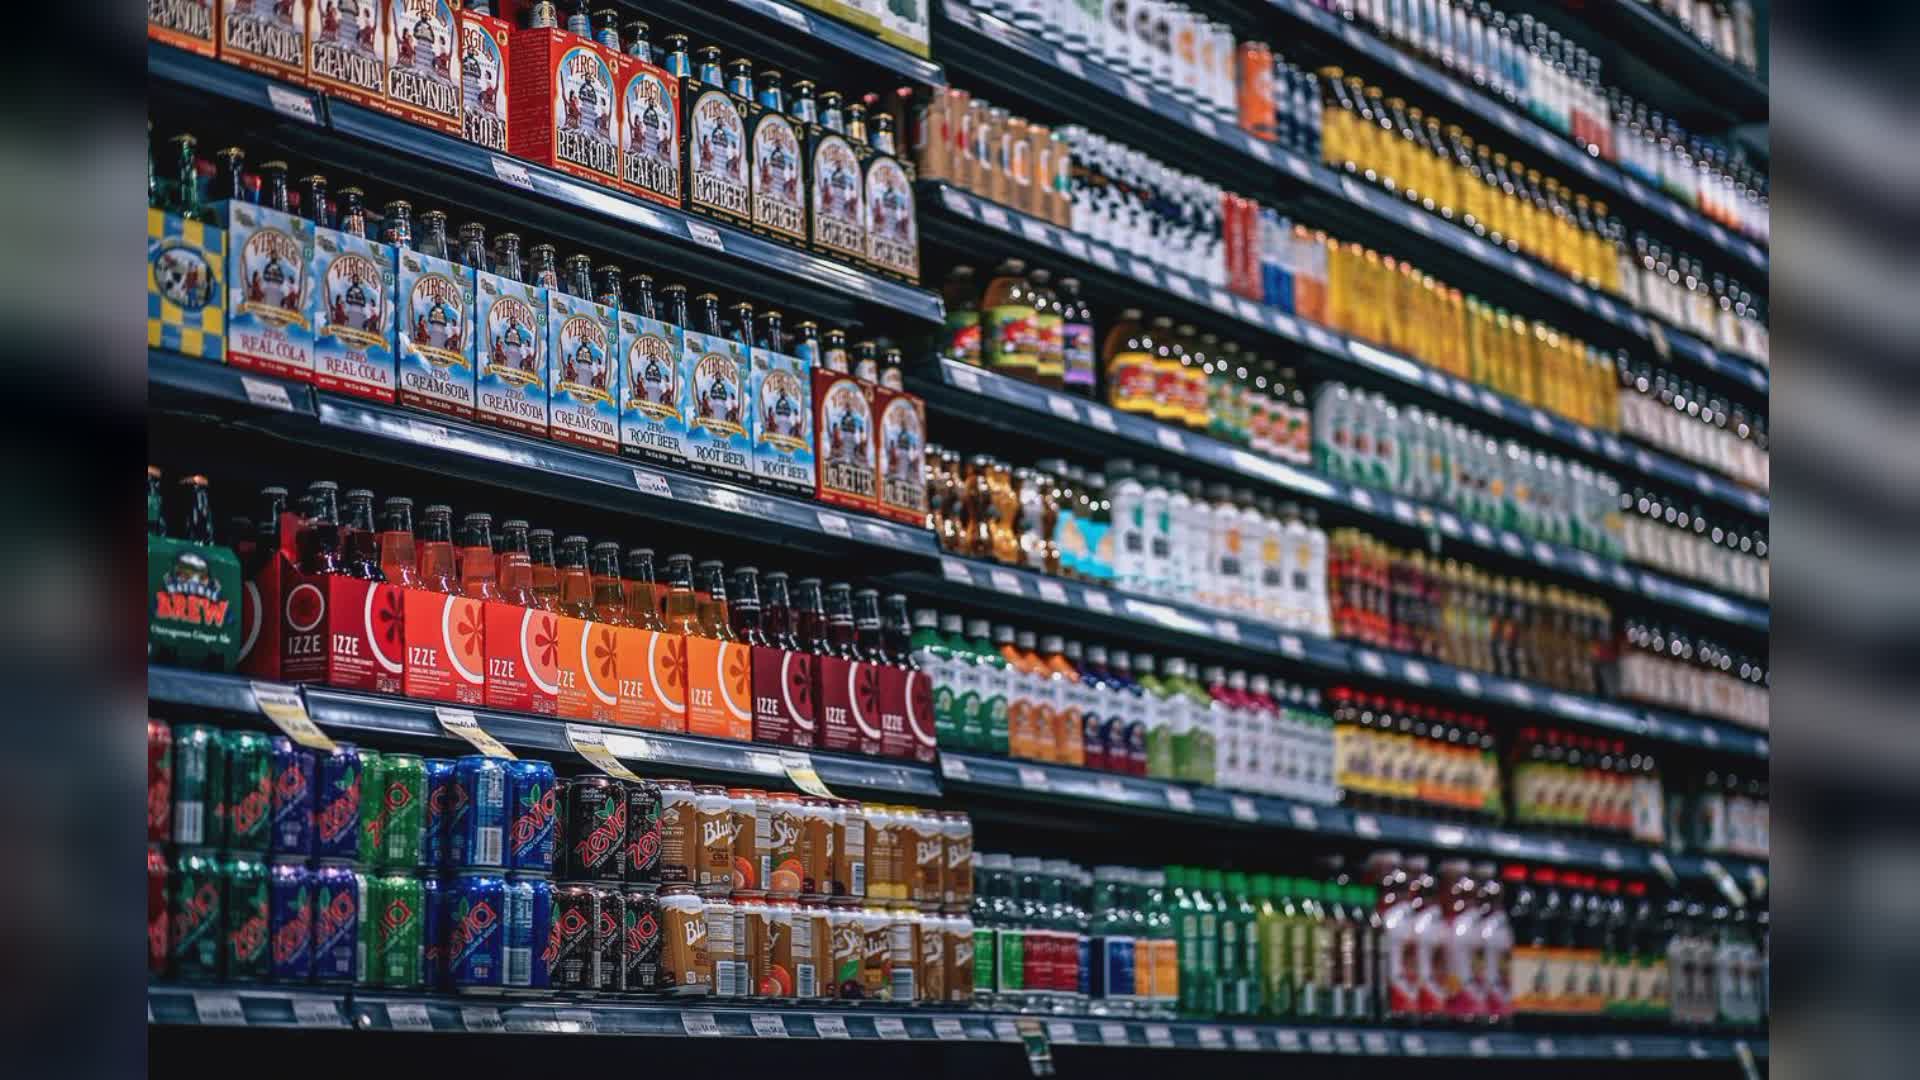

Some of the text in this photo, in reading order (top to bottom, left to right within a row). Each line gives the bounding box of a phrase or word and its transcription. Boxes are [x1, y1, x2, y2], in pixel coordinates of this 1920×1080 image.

[557, 127, 589, 166] REAL
[589, 141, 619, 178] COLA
[623, 153, 652, 188] REAL
[651, 161, 679, 200] COLA
[239, 334, 307, 363] REAL COLA
[324, 356, 357, 376] REAL
[357, 363, 388, 384] COLA
[405, 372, 444, 394] CREAM
[444, 382, 470, 402] SODA
[481, 393, 518, 416] CREAM
[518, 401, 545, 421] SODA
[554, 408, 590, 432] CREAM
[590, 420, 615, 437] SODA
[628, 427, 656, 446] ROOT
[656, 434, 682, 453] BEER
[694, 444, 722, 465] ROOT
[722, 451, 748, 470] BEER
[156, 591, 229, 628] BREW
[289, 634, 321, 655] IZZE
[332, 633, 359, 656] IZZE
[408, 646, 437, 667] IZZE
[489, 657, 515, 678] IZZE
[556, 669, 575, 689] ZZE
[618, 679, 643, 698] IZZE
[690, 687, 713, 707] IZZE
[756, 696, 779, 716] IZZE
[825, 706, 847, 725] IZZE
[881, 713, 904, 732] IZZE
